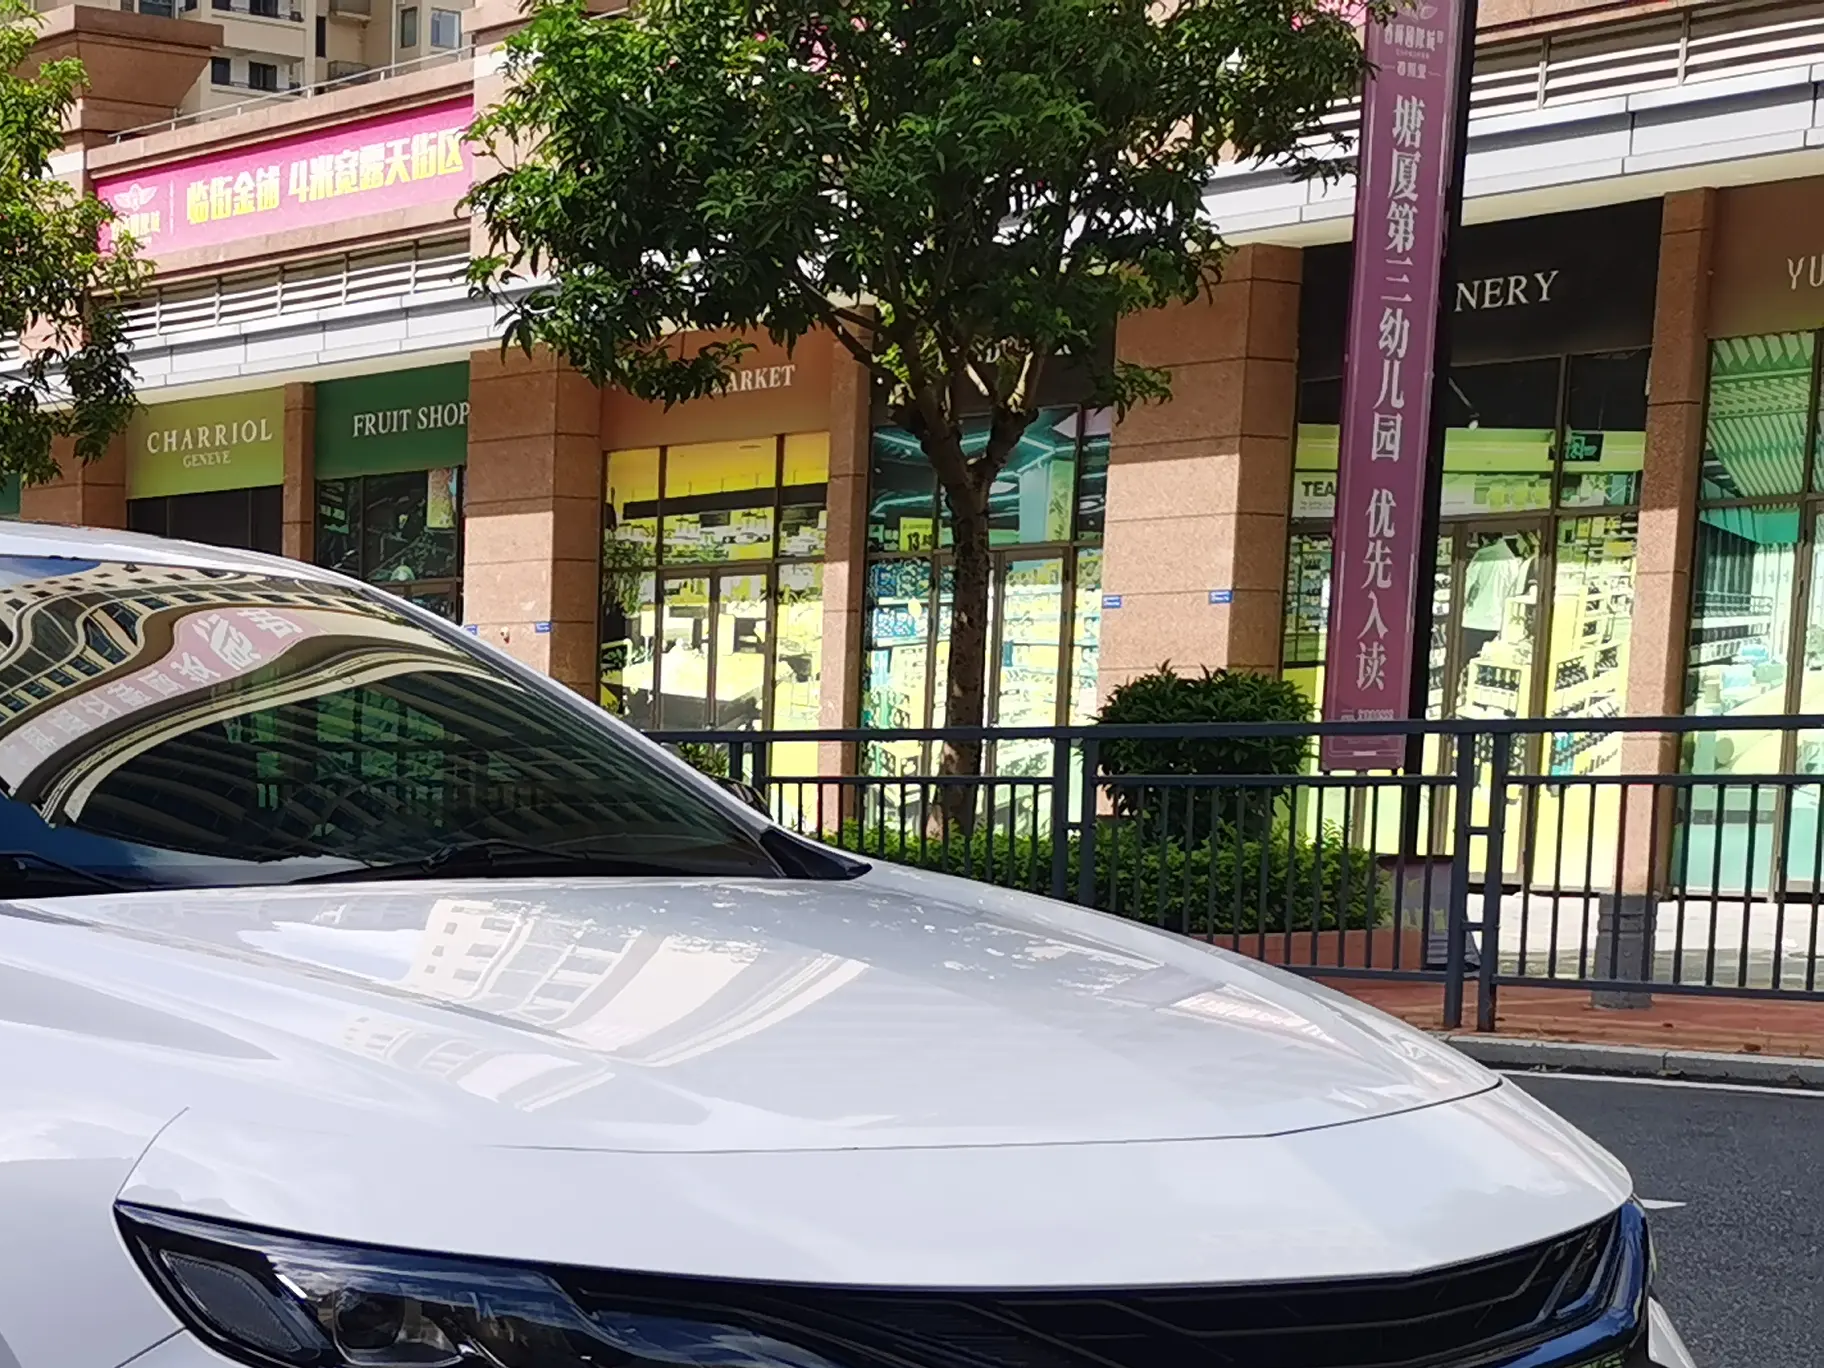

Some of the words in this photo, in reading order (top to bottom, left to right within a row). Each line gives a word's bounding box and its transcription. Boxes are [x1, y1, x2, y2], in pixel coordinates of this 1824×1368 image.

[186, 166, 280, 225] 临街金铺
[1371, 94, 1425, 463] 塘厦第三幼儿园
[147, 417, 273, 454] CHARRIOL
[352, 407, 412, 438] FRUIT
[416, 401, 471, 431] SHOP
[1302, 480, 1336, 497] TEA
[1356, 488, 1397, 692] 优先入读
